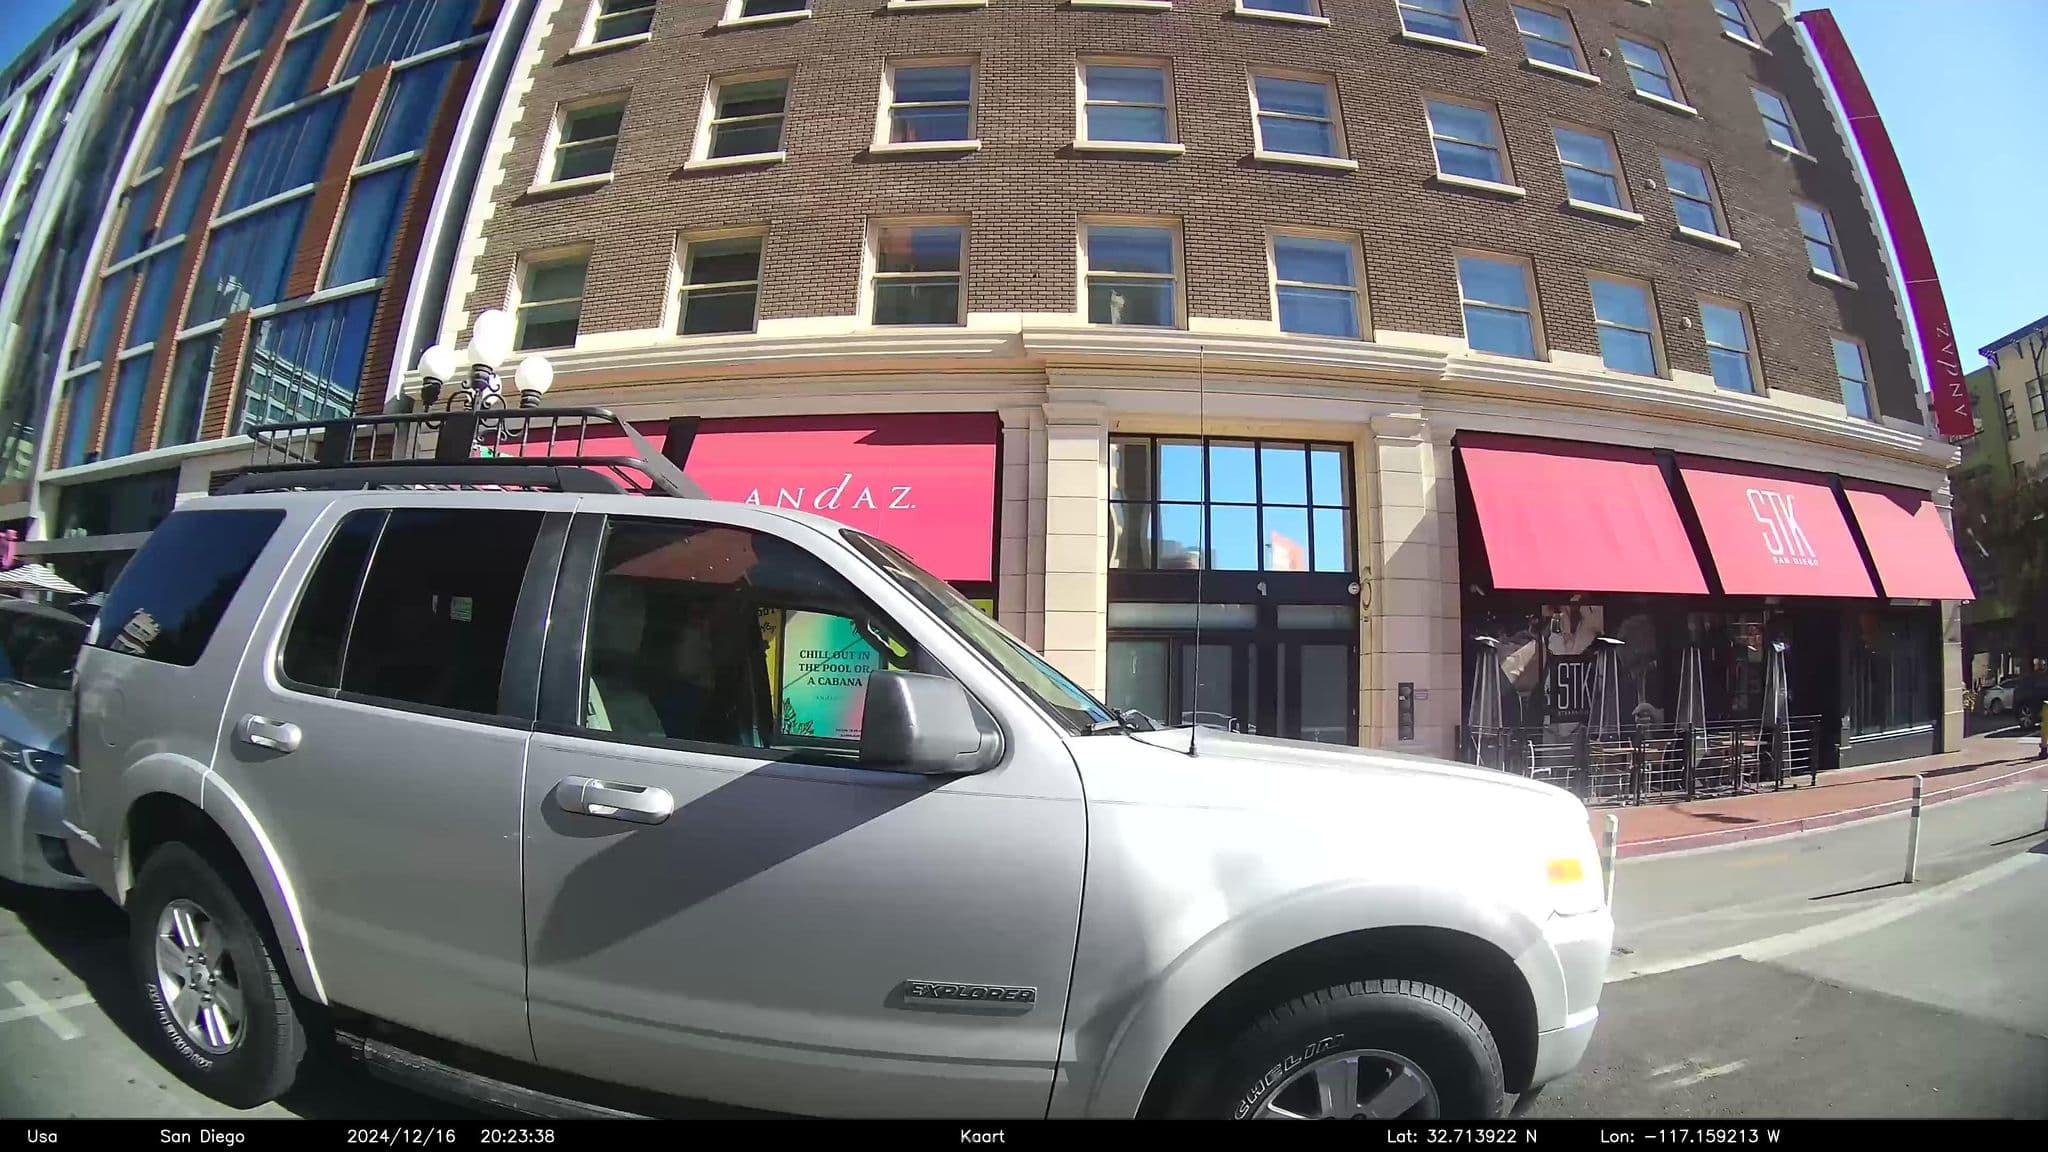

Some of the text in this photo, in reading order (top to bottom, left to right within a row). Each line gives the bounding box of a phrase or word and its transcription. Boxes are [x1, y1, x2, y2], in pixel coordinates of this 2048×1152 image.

[1746, 488, 1816, 558] STK
[799, 650, 871, 660] CHILL OUT IN
[798, 663, 820, 672] THE
[822, 663, 852, 673] POOL
[807, 677, 863, 687] A CABANA
[1558, 662, 1593, 710] STK
[911, 982, 1036, 1002] EXPLORER
[1233, 1033, 1345, 1120] CHELIN
